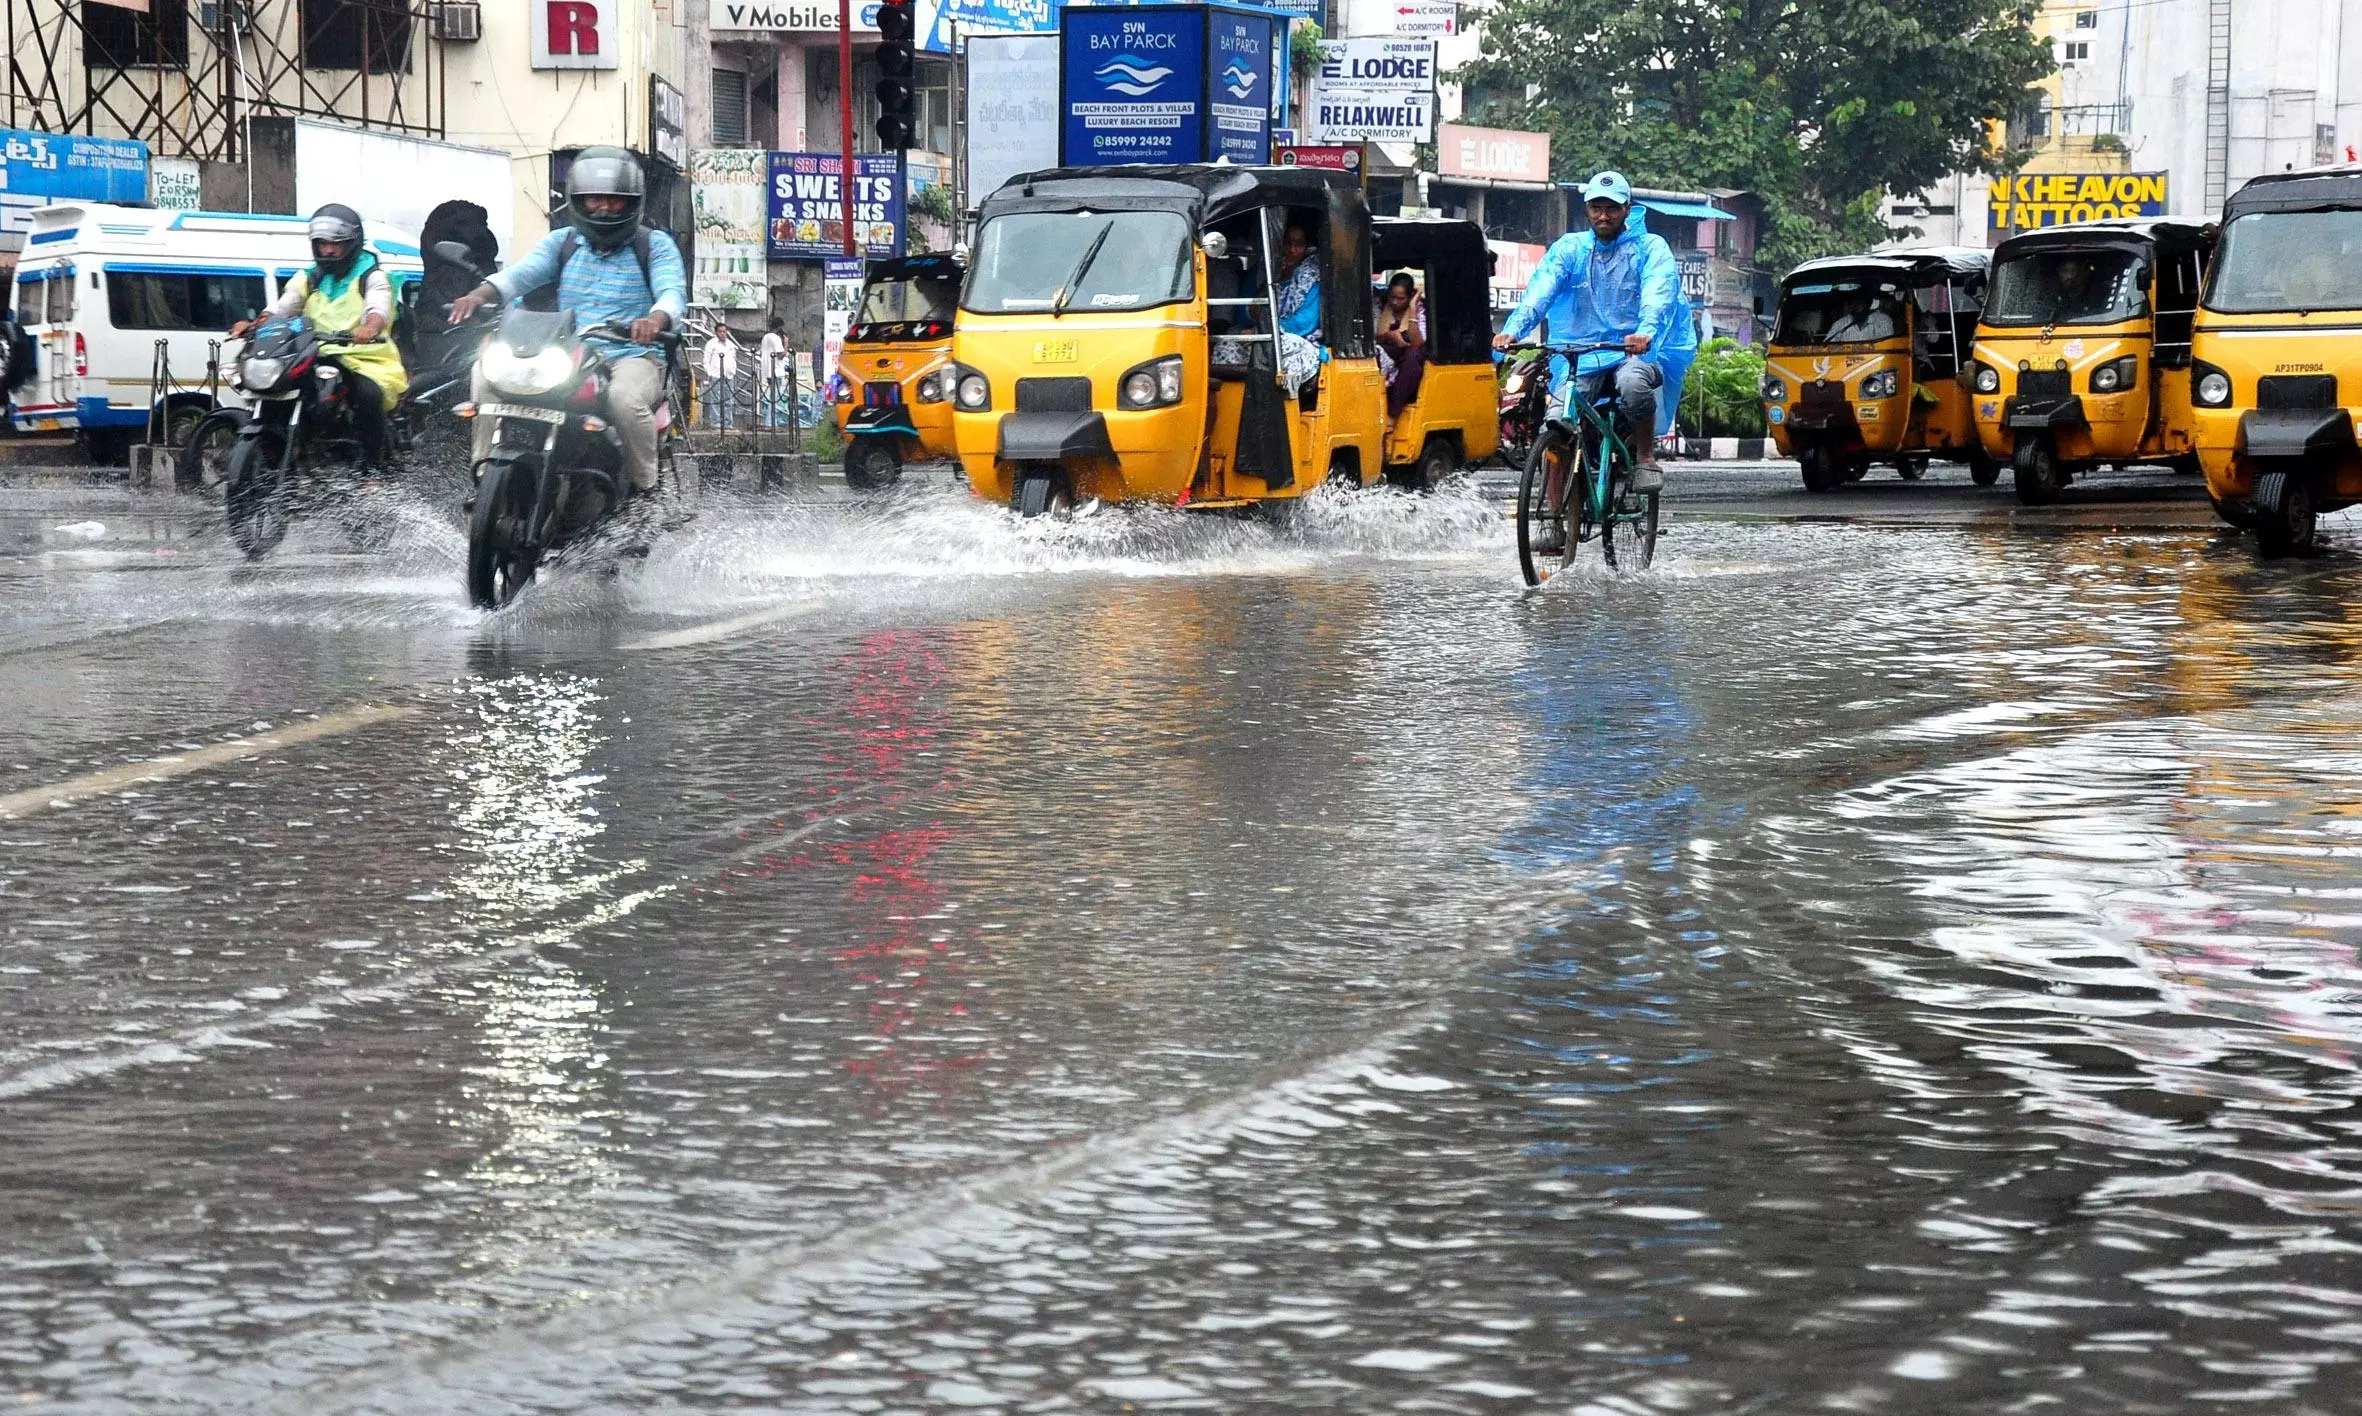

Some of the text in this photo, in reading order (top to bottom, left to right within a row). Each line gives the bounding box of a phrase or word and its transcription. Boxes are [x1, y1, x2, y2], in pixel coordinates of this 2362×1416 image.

[726, 5, 747, 27] V
[1416, 7, 1427, 15] A/C
[547, 1, 599, 55] R
[1123, 22, 1145, 33] SVN
[1235, 25, 1246, 36] SVN
[1396, 23, 1444, 31] A/C DORMITORY
[1091, 34, 1176, 49] BAY PARCK
[1221, 35, 1259, 54] BAY PARCK
[1074, 105, 1100, 113] BEACH
[1102, 105, 1128, 113] FRONT
[1131, 105, 1154, 113] PLOTS
[1165, 104, 1192, 112] VILLAS
[1088, 116, 1178, 126] LUXURY BEACH RESORT
[1320, 105, 1423, 127] RELAXWELL
[1330, 128, 1412, 138] A/C DORMITORY
[1105, 136, 1172, 146] 85999 24242
[116, 146, 138, 158] DEALER
[794, 157, 817, 173] SRI
[776, 174, 891, 202] SWETS
[782, 202, 796, 218] &
[1684, 262, 1700, 274] CARE
[2275, 363, 2324, 372] AP31TP0904
